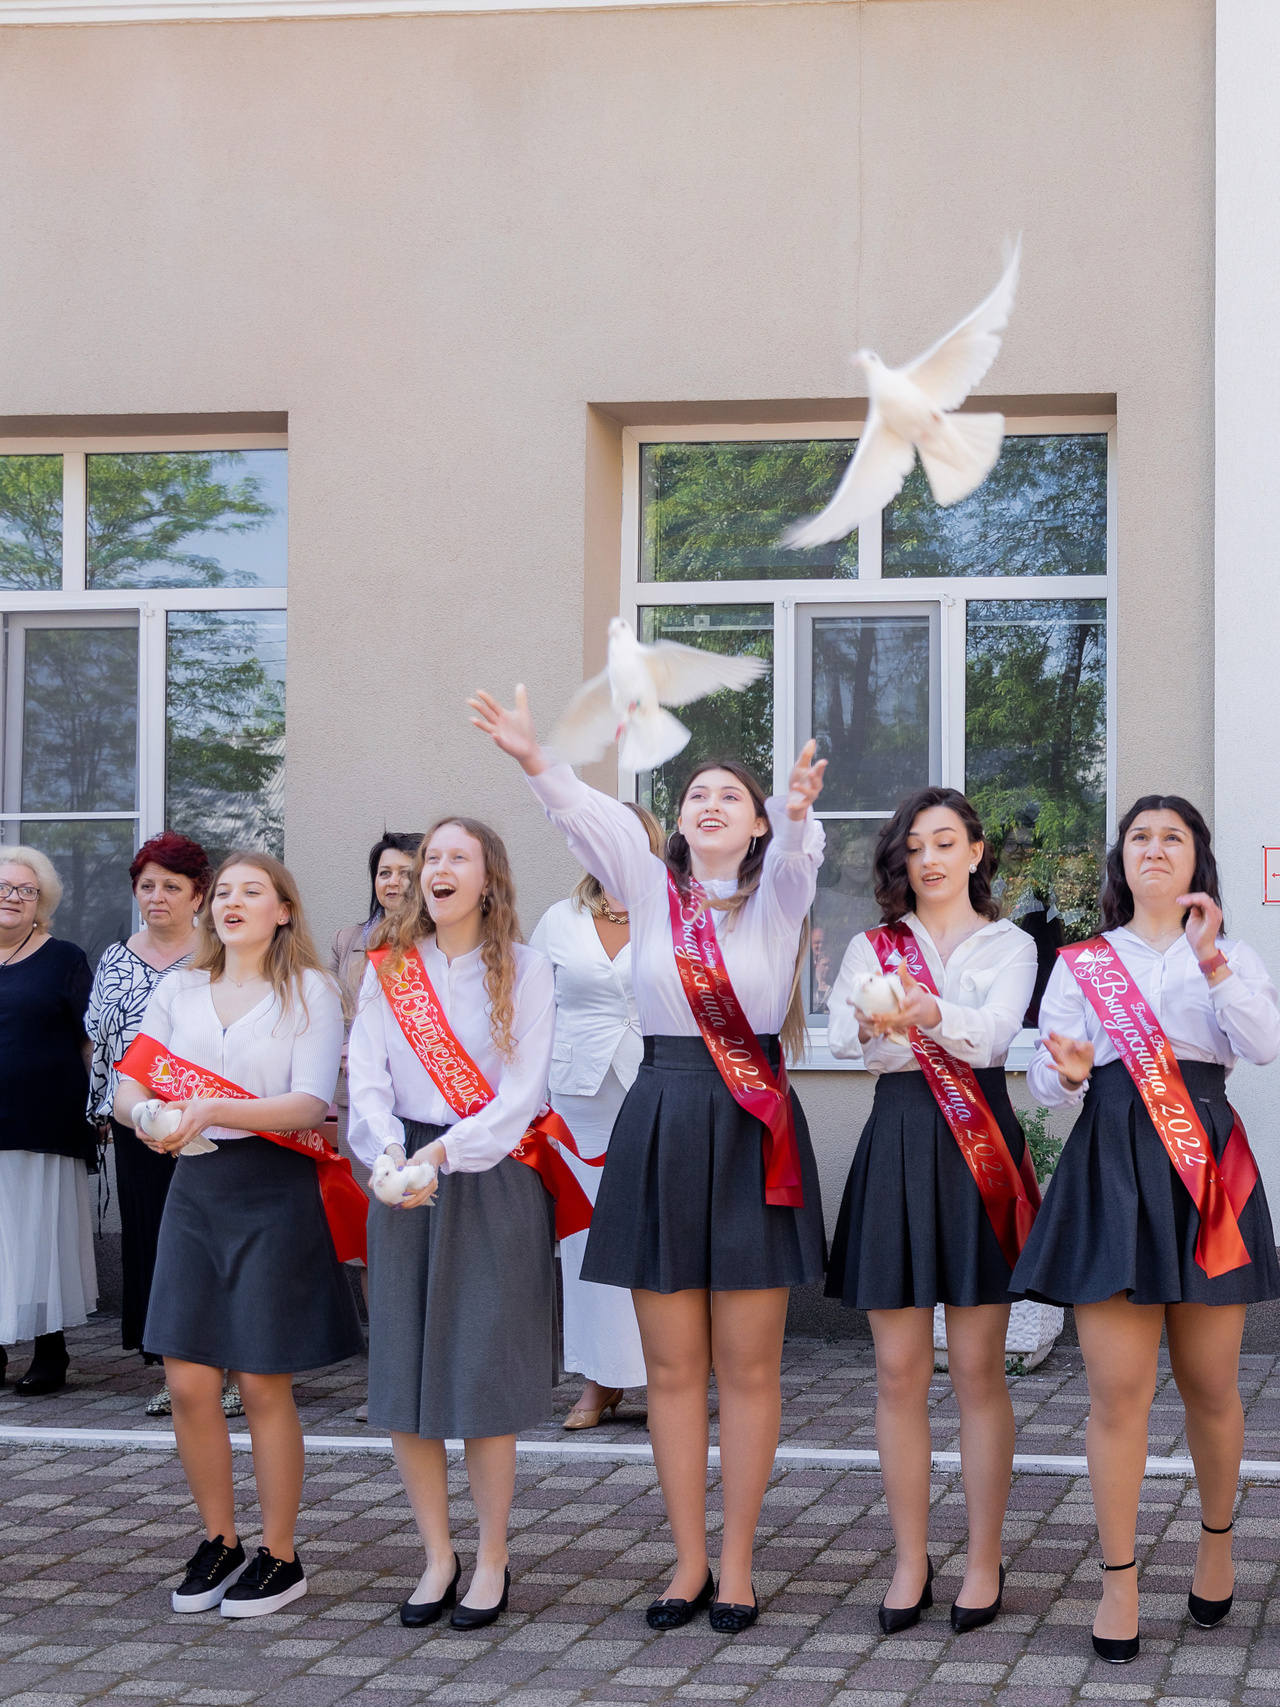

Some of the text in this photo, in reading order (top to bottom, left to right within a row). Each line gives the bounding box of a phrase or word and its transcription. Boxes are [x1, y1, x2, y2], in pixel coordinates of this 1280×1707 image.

[391, 980, 483, 1114] Выпускник
[718, 1034, 766, 1094] 2022
[1091, 971, 1168, 1095] Выпускница
[1159, 1103, 1206, 1168] 2022
[965, 1129, 1010, 1188] 2022
